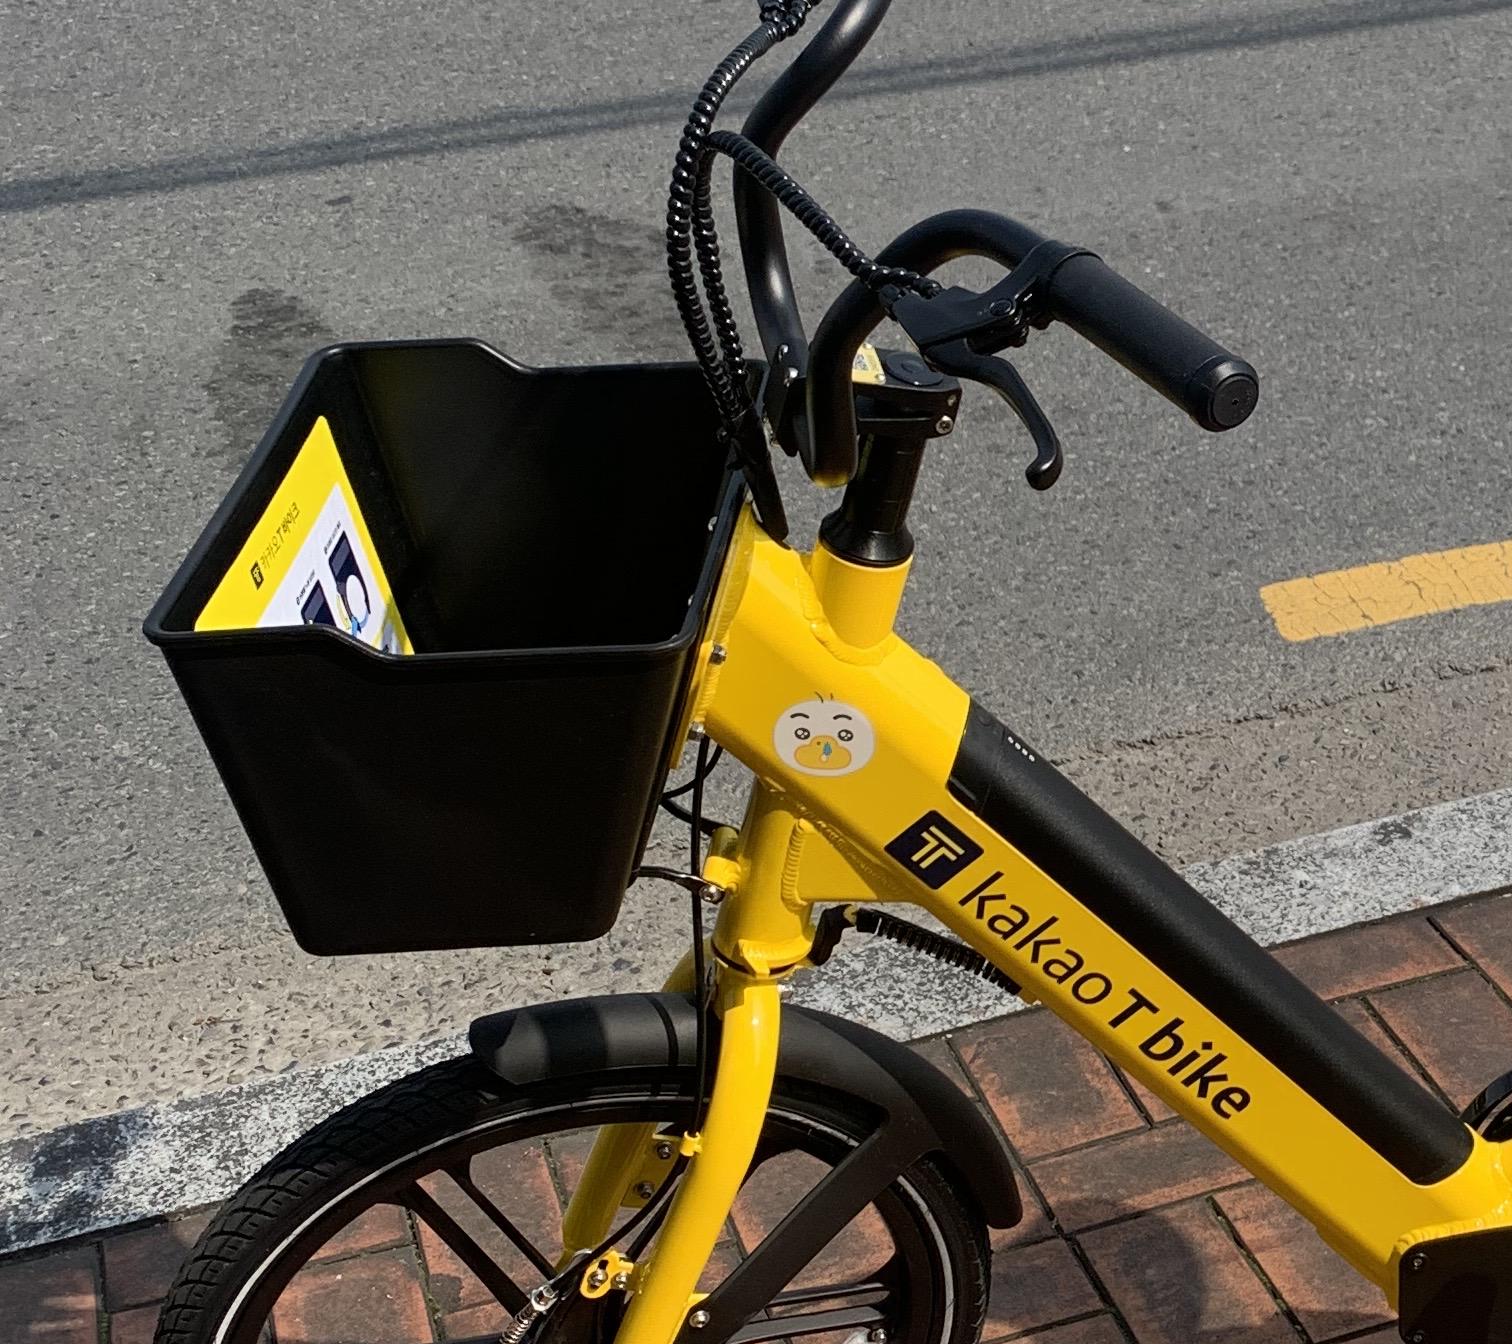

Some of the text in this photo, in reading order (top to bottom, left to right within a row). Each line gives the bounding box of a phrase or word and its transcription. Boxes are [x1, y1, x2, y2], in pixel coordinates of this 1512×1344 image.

[958, 871, 1251, 1119] kakao T bike
